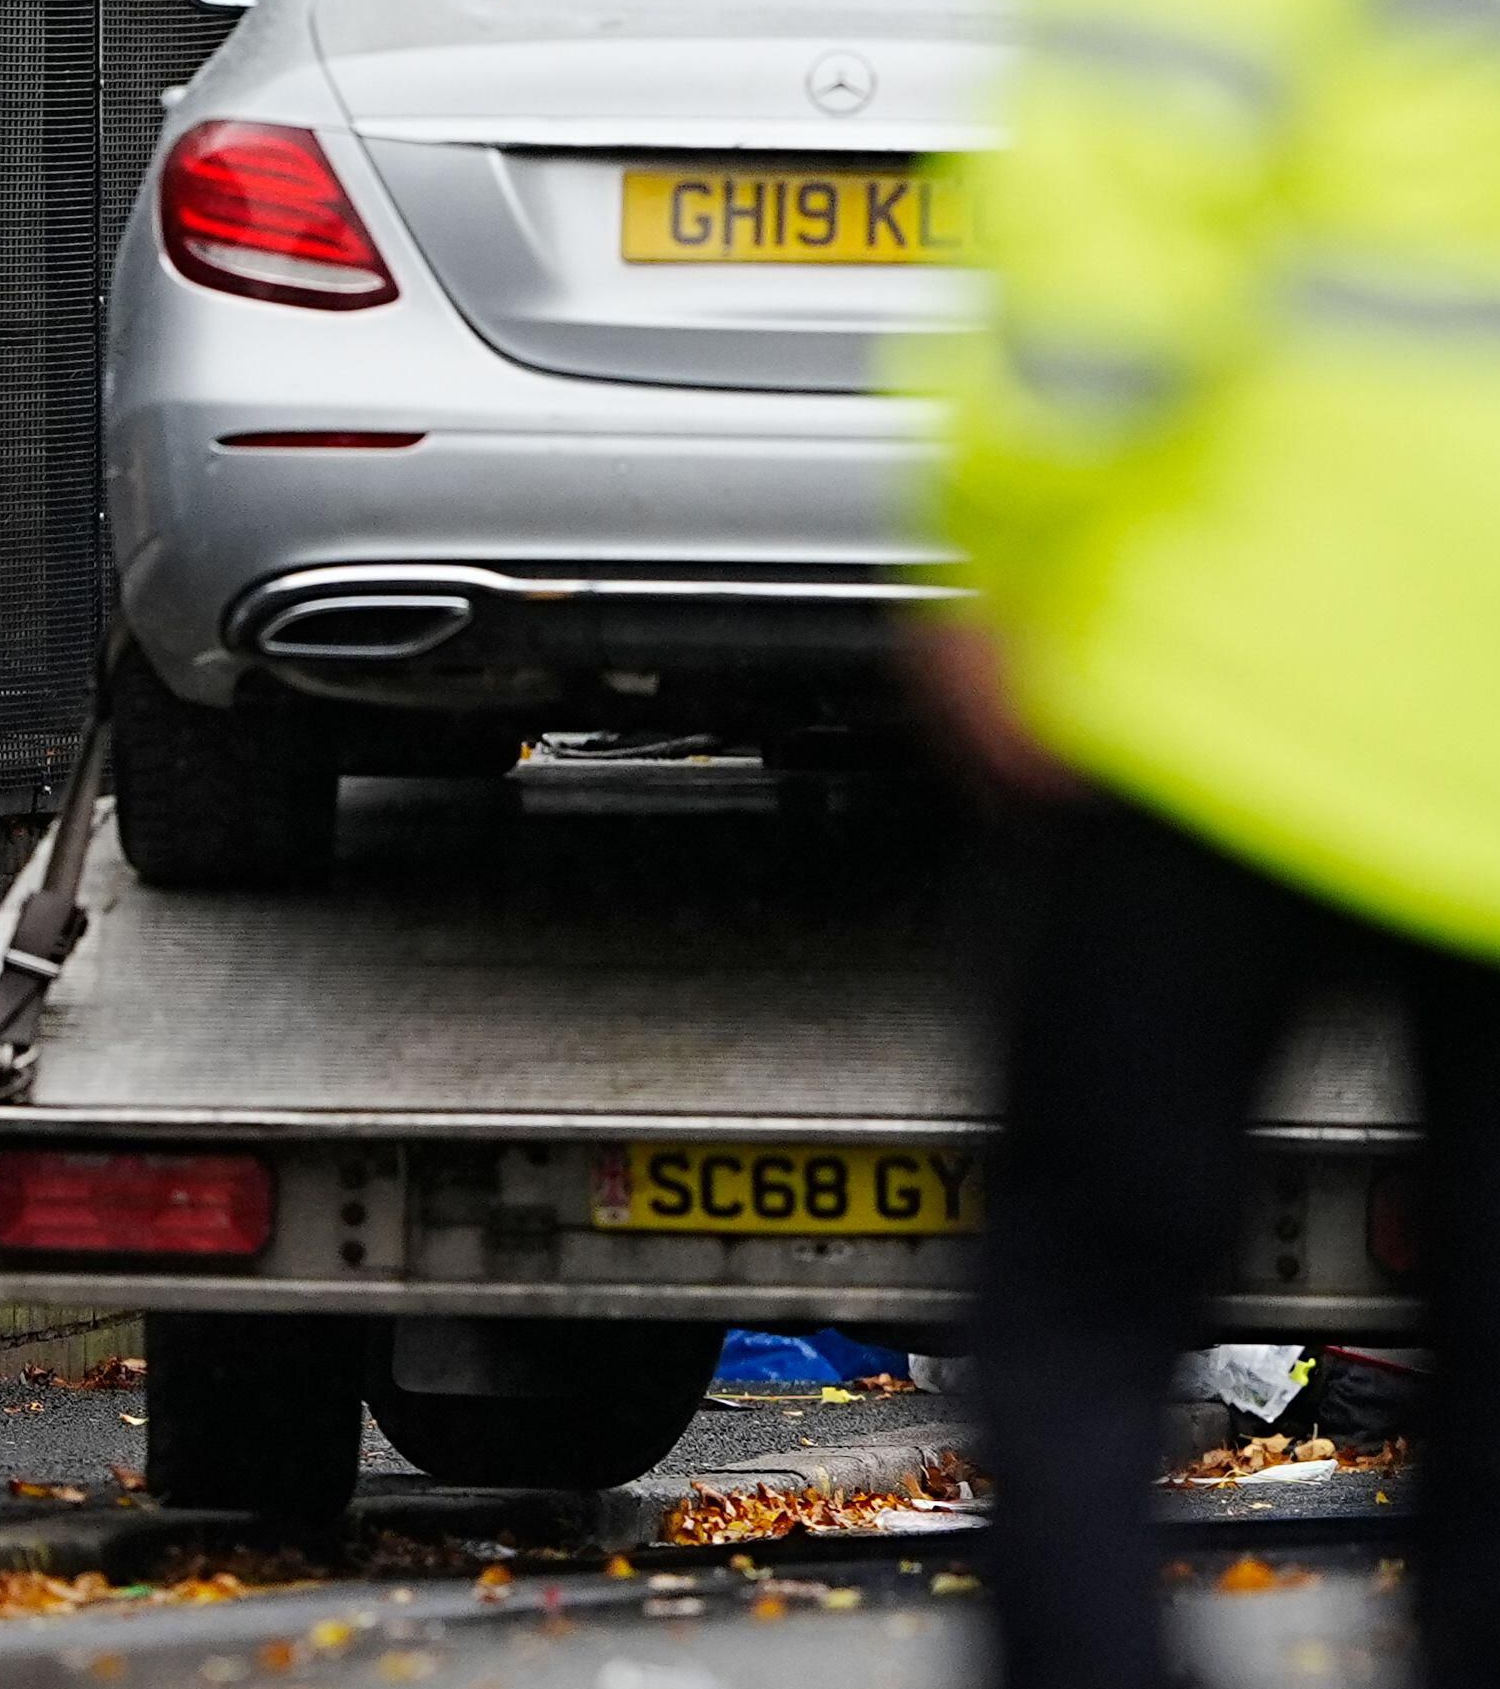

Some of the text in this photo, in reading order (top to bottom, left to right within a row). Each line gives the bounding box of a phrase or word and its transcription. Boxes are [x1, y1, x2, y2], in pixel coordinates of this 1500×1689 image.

[668, 179, 988, 248] GH19 KL
[647, 1152, 976, 1223] SC68 GY
